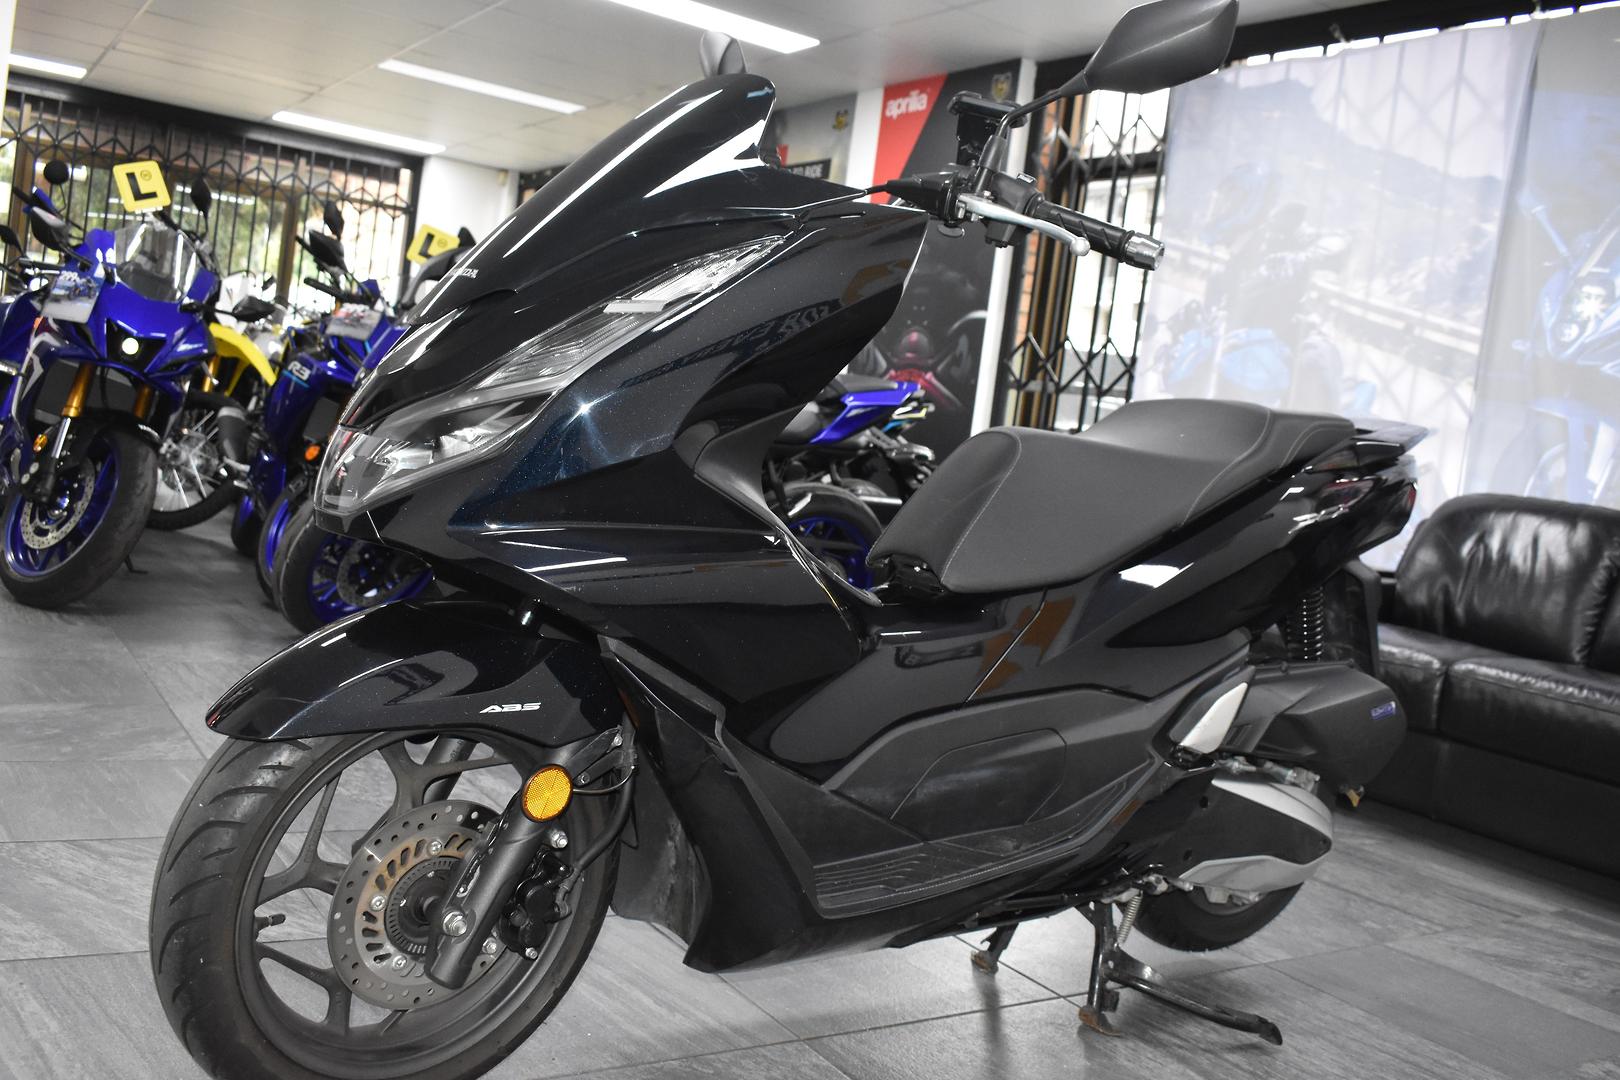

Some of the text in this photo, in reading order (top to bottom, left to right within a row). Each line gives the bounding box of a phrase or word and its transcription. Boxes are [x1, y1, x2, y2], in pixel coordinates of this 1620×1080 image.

[885, 89, 928, 120] aprilia
[126, 172, 158, 201] L
[288, 360, 312, 382] R3
[479, 702, 542, 714] ABS
